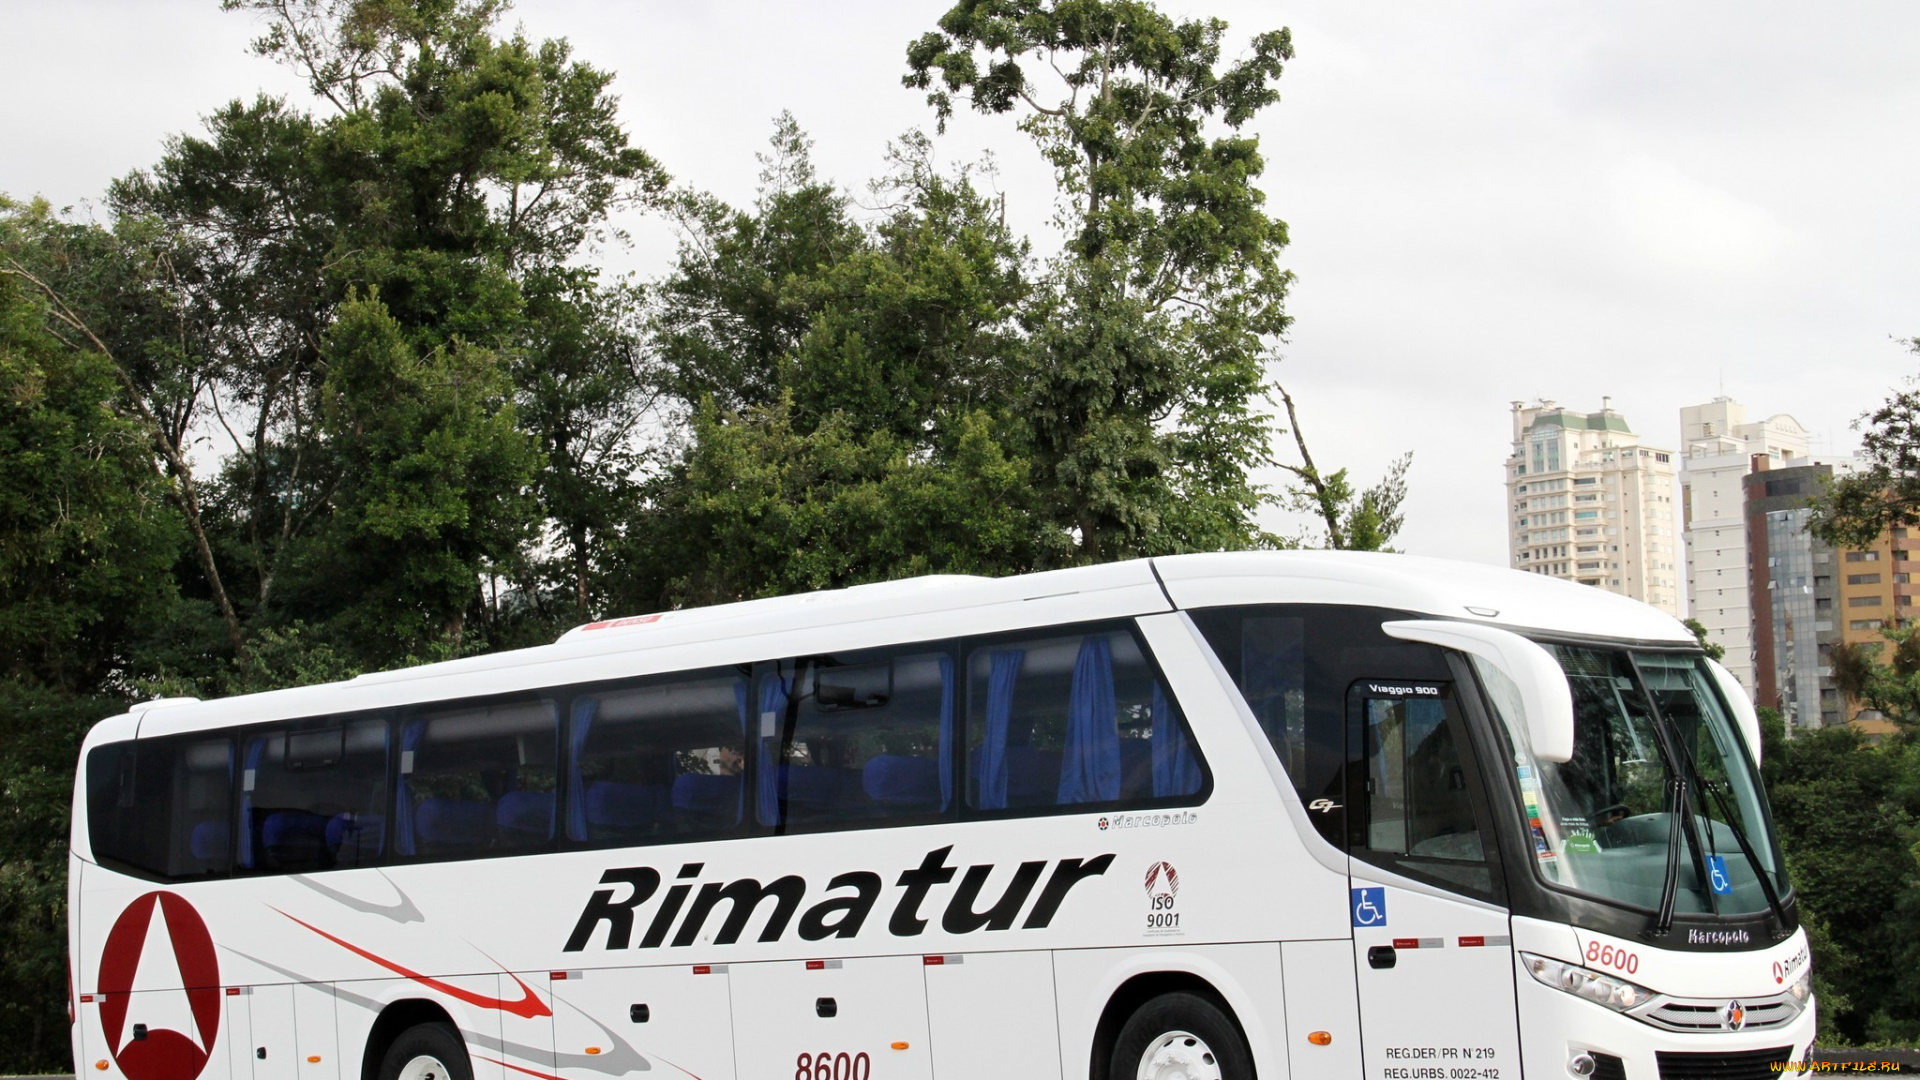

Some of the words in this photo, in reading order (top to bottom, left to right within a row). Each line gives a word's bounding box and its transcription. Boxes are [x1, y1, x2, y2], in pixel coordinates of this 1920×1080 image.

[1368, 684, 1414, 695] Viaggio
[1415, 686, 1438, 695] 900
[1111, 811, 1198, 829] Marcopolo
[562, 844, 1117, 953] Rimatur
[1151, 896, 1174, 911] ISO
[1147, 912, 1180, 928] 9001
[1687, 928, 1750, 946] Marcopolo
[1586, 940, 1639, 975] 8600
[795, 1051, 870, 1080] 8600
[1383, 1067, 1449, 1080] REG.URBS.
[1450, 1067, 1500, 1080] 0022-412
